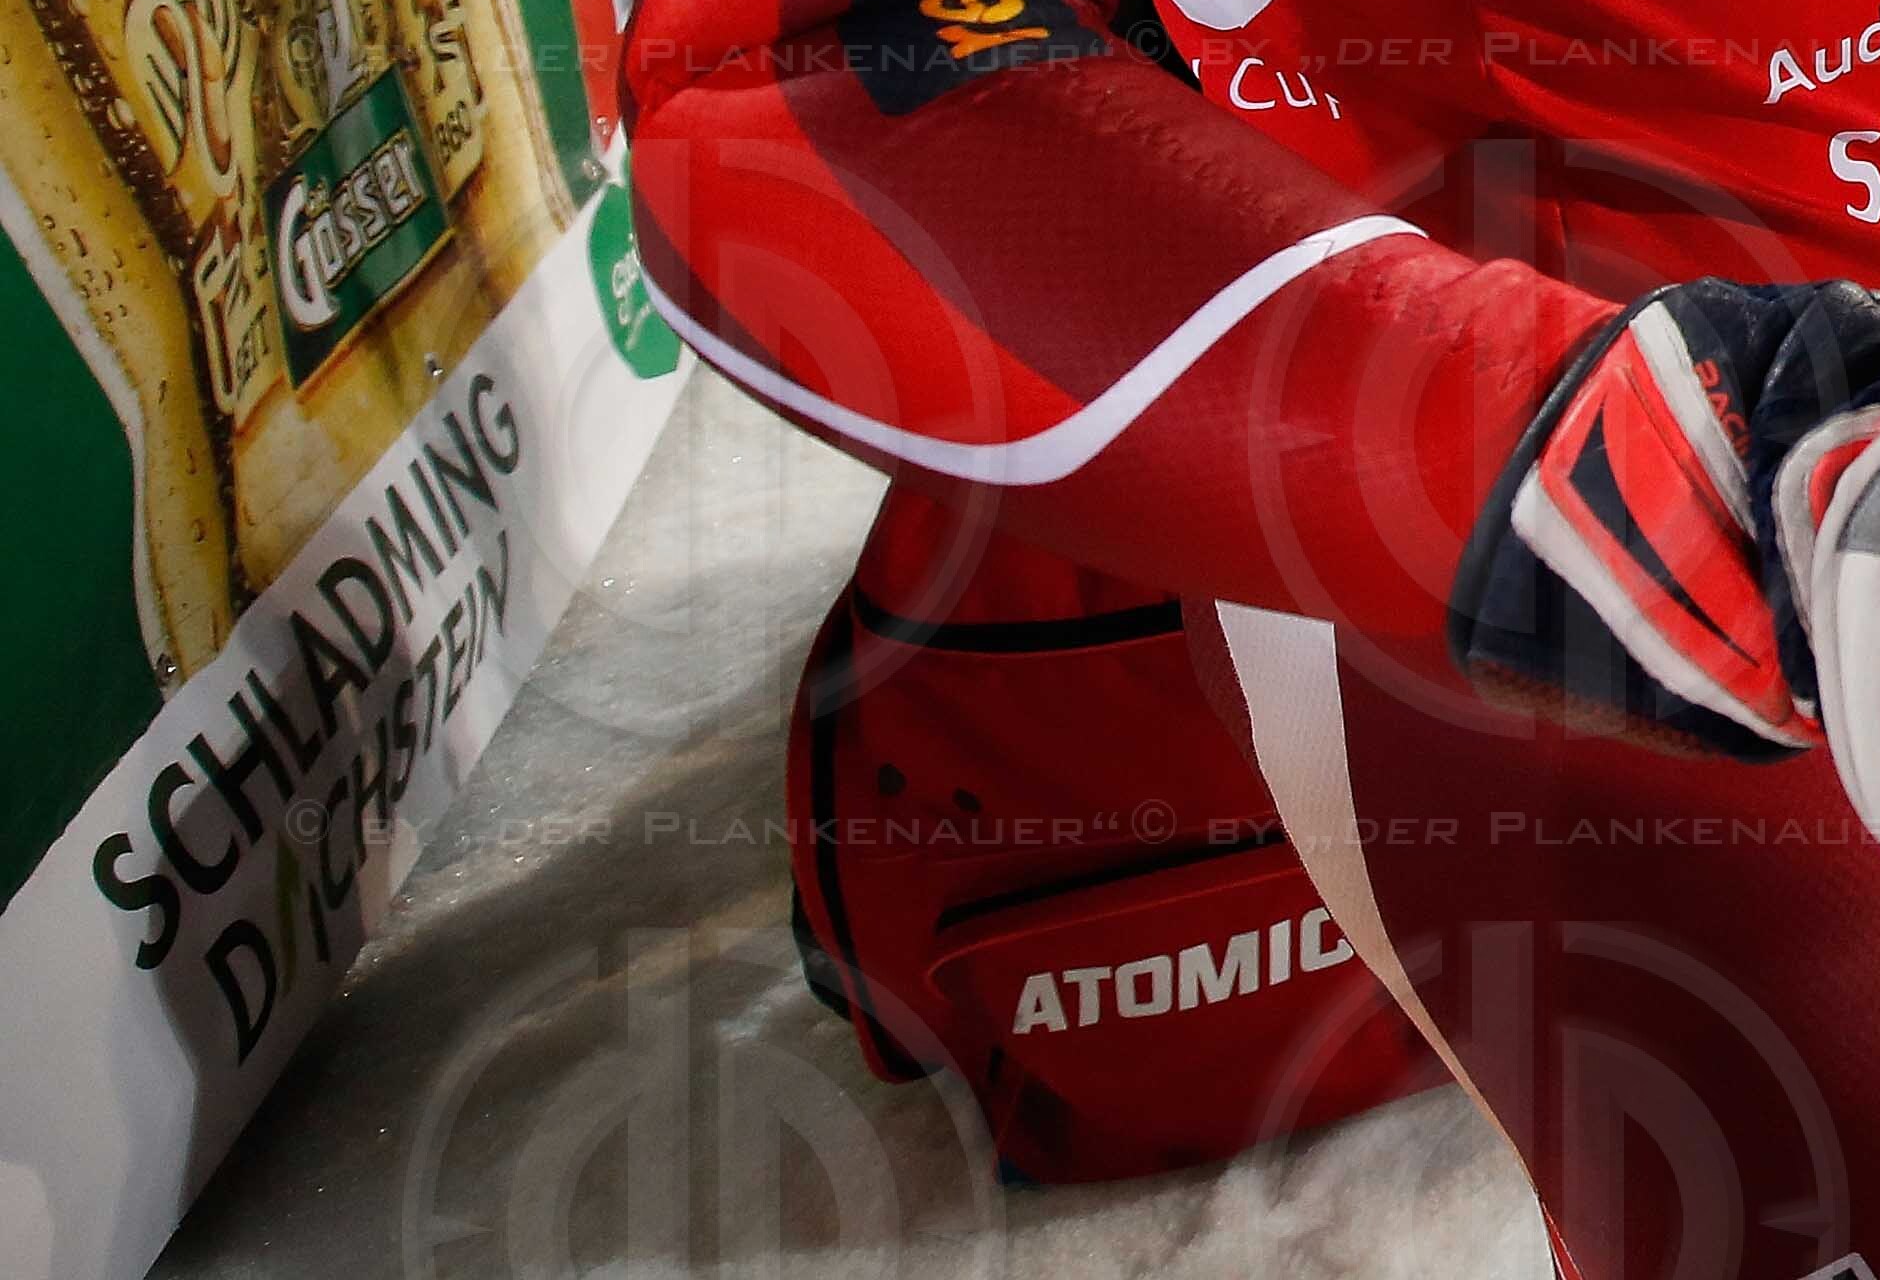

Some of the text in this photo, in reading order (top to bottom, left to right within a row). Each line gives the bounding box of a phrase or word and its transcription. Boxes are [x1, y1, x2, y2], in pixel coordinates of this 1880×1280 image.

[92, 373, 522, 972] SCHLADMING
[204, 530, 512, 1069] DACHSTEIN
[1012, 907, 1357, 1036] ATOMIC
